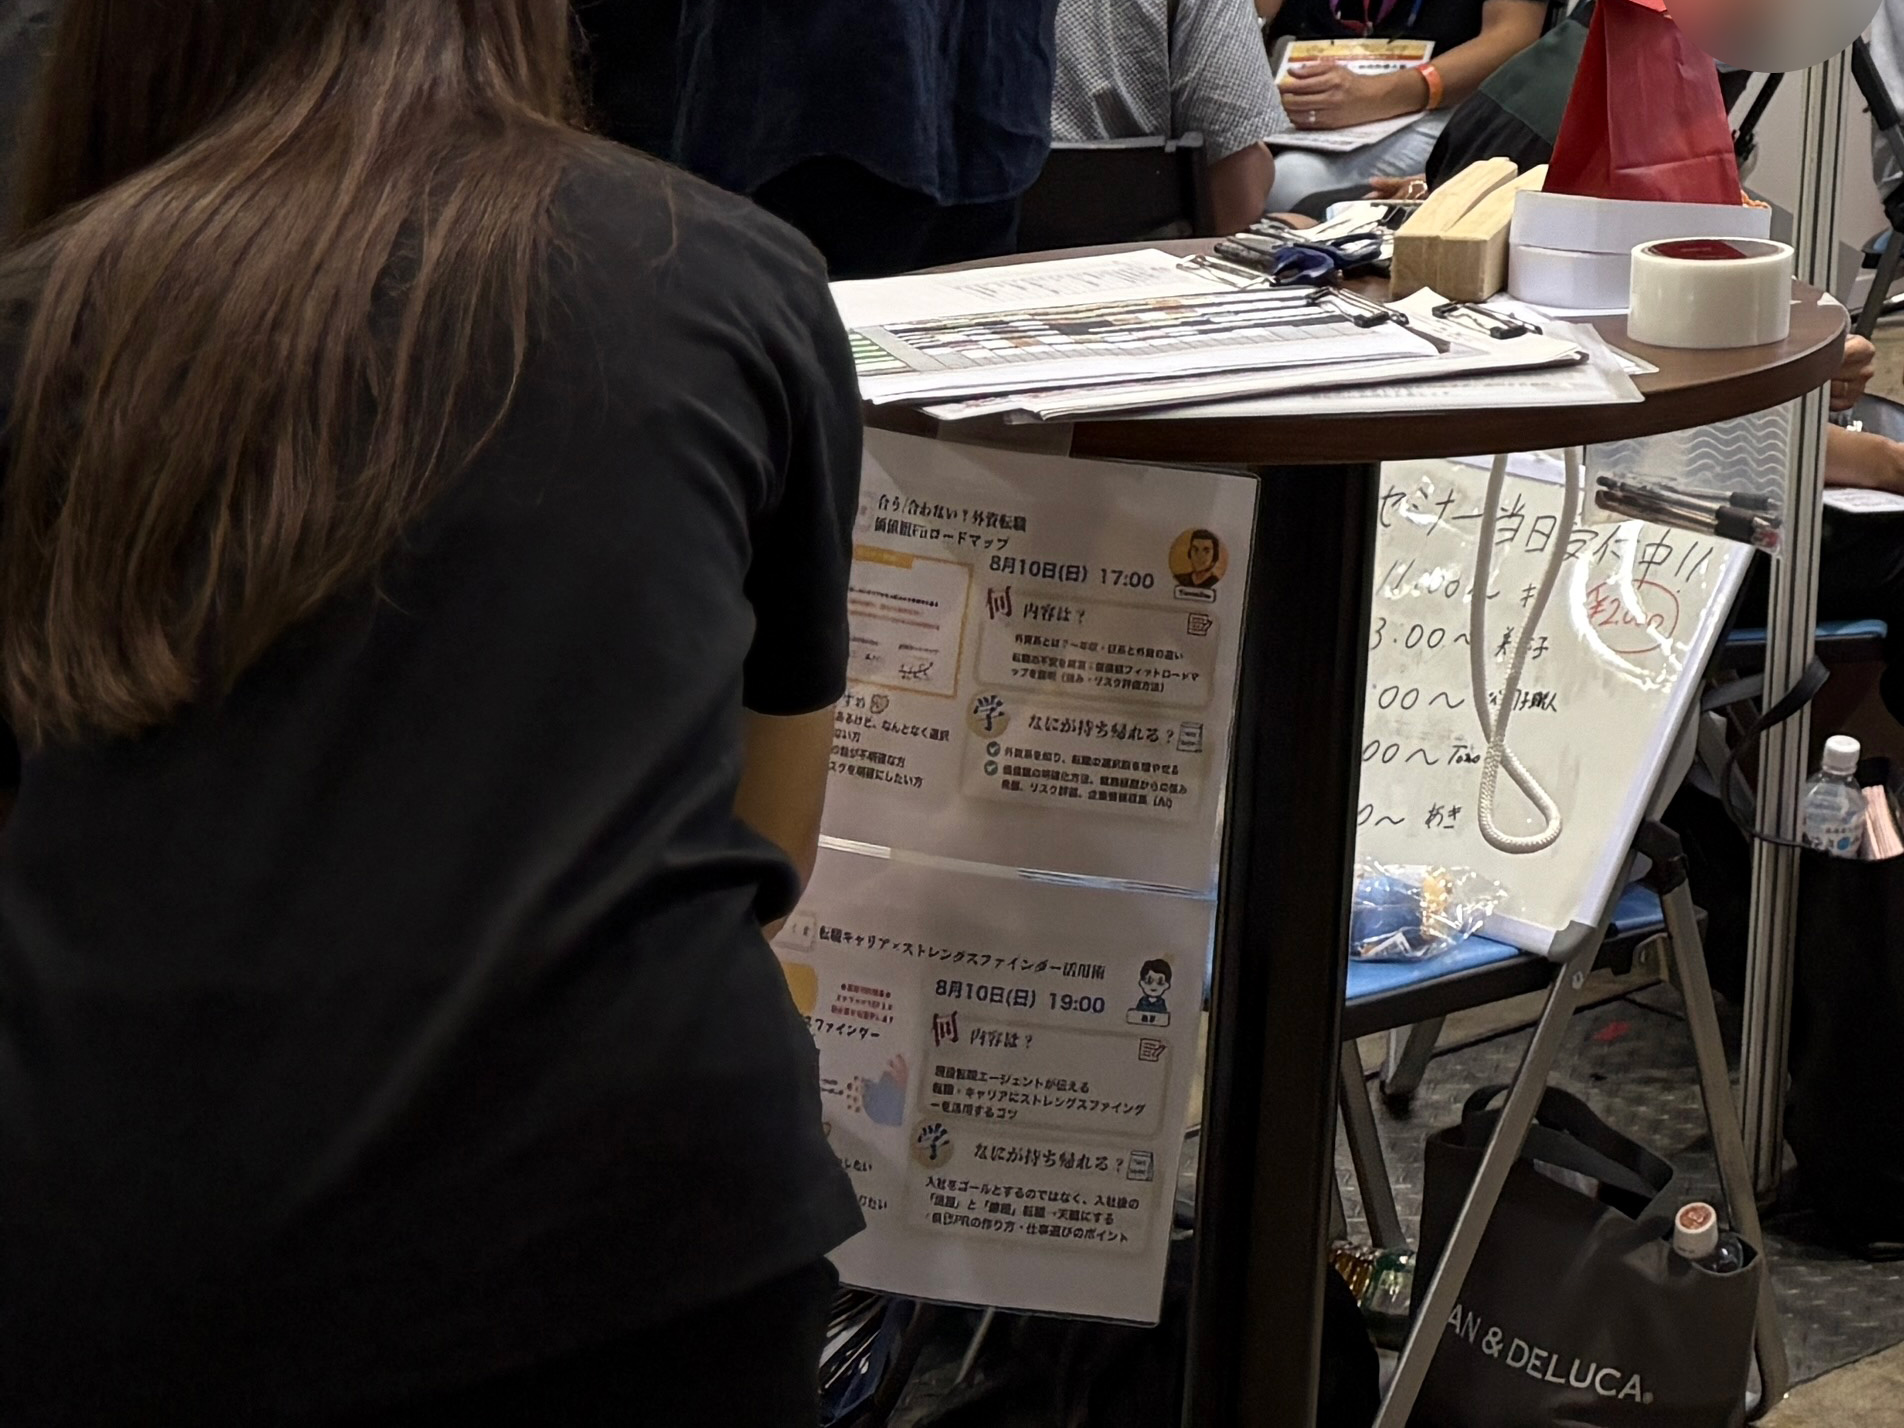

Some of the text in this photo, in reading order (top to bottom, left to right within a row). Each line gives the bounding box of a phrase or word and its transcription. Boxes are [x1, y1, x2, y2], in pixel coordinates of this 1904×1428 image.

[989, 555, 1155, 589] 8月10日(日) 17:00
[986, 585, 1013, 620] 何
[973, 694, 1005, 731] 学
[1028, 714, 1175, 744] なにが持ち帰れる？
[1425, 804, 1462, 829] あき
[935, 979, 1105, 1014] 8月10日(日) 19:00
[1447, 1302, 1480, 1342] AN
[1481, 1326, 1504, 1358] &
